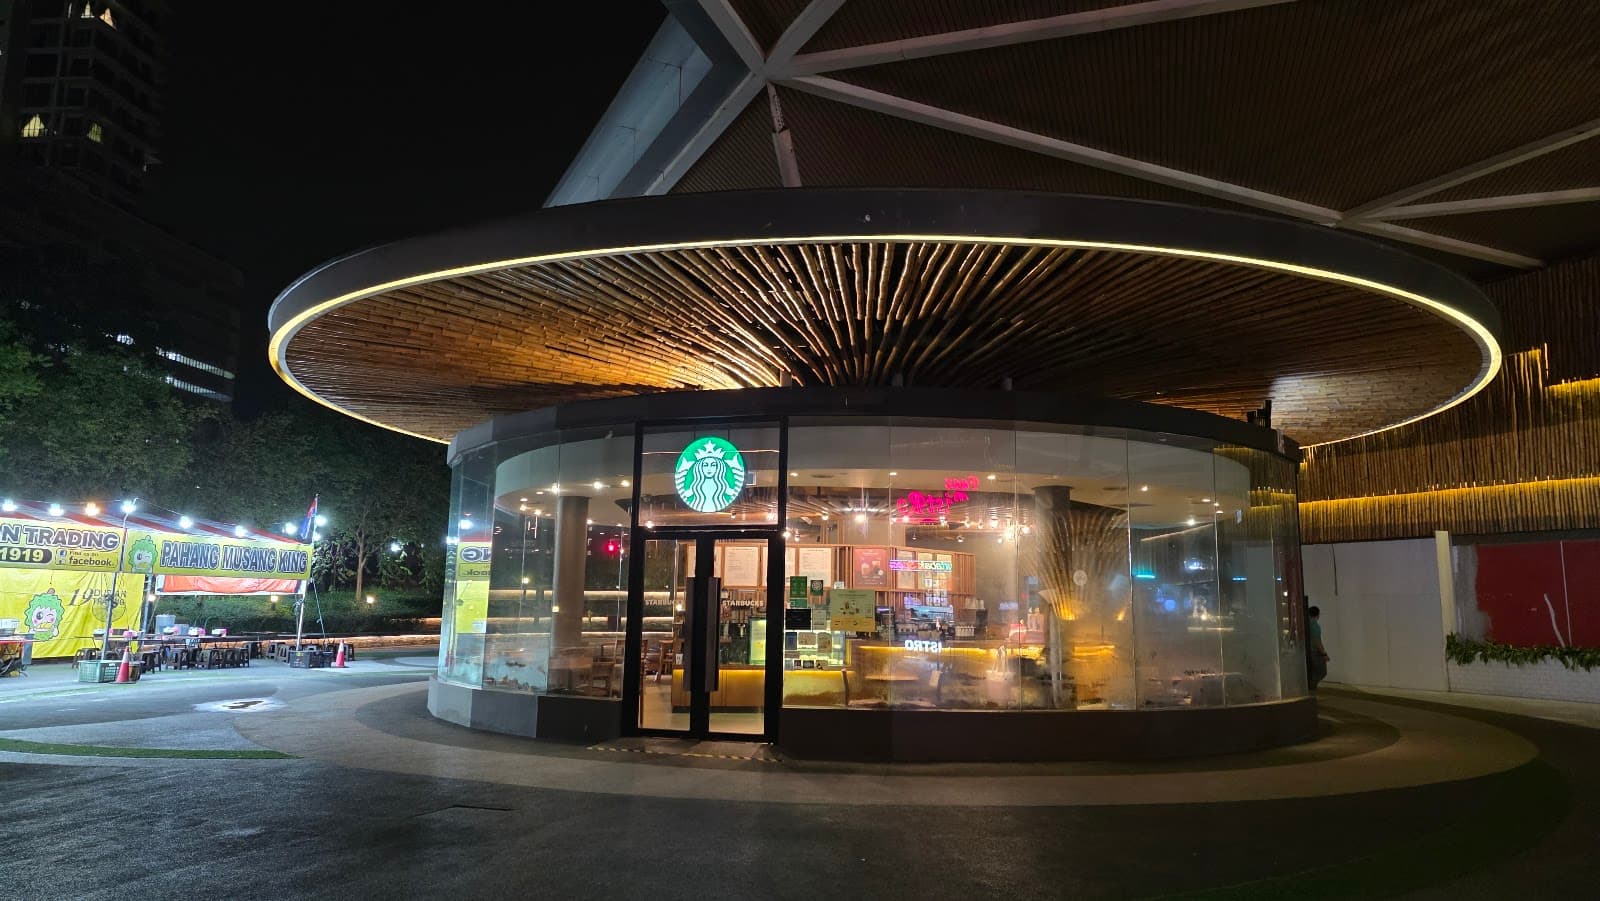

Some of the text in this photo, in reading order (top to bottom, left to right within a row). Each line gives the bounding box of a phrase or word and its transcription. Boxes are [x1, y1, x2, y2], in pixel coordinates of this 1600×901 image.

[23, 525, 120, 552] TRADING
[0, 547, 44, 562] 1919
[160, 540, 308, 574] PAHANG MUSANG KING
[722, 599, 764, 607] STARBUCKS
